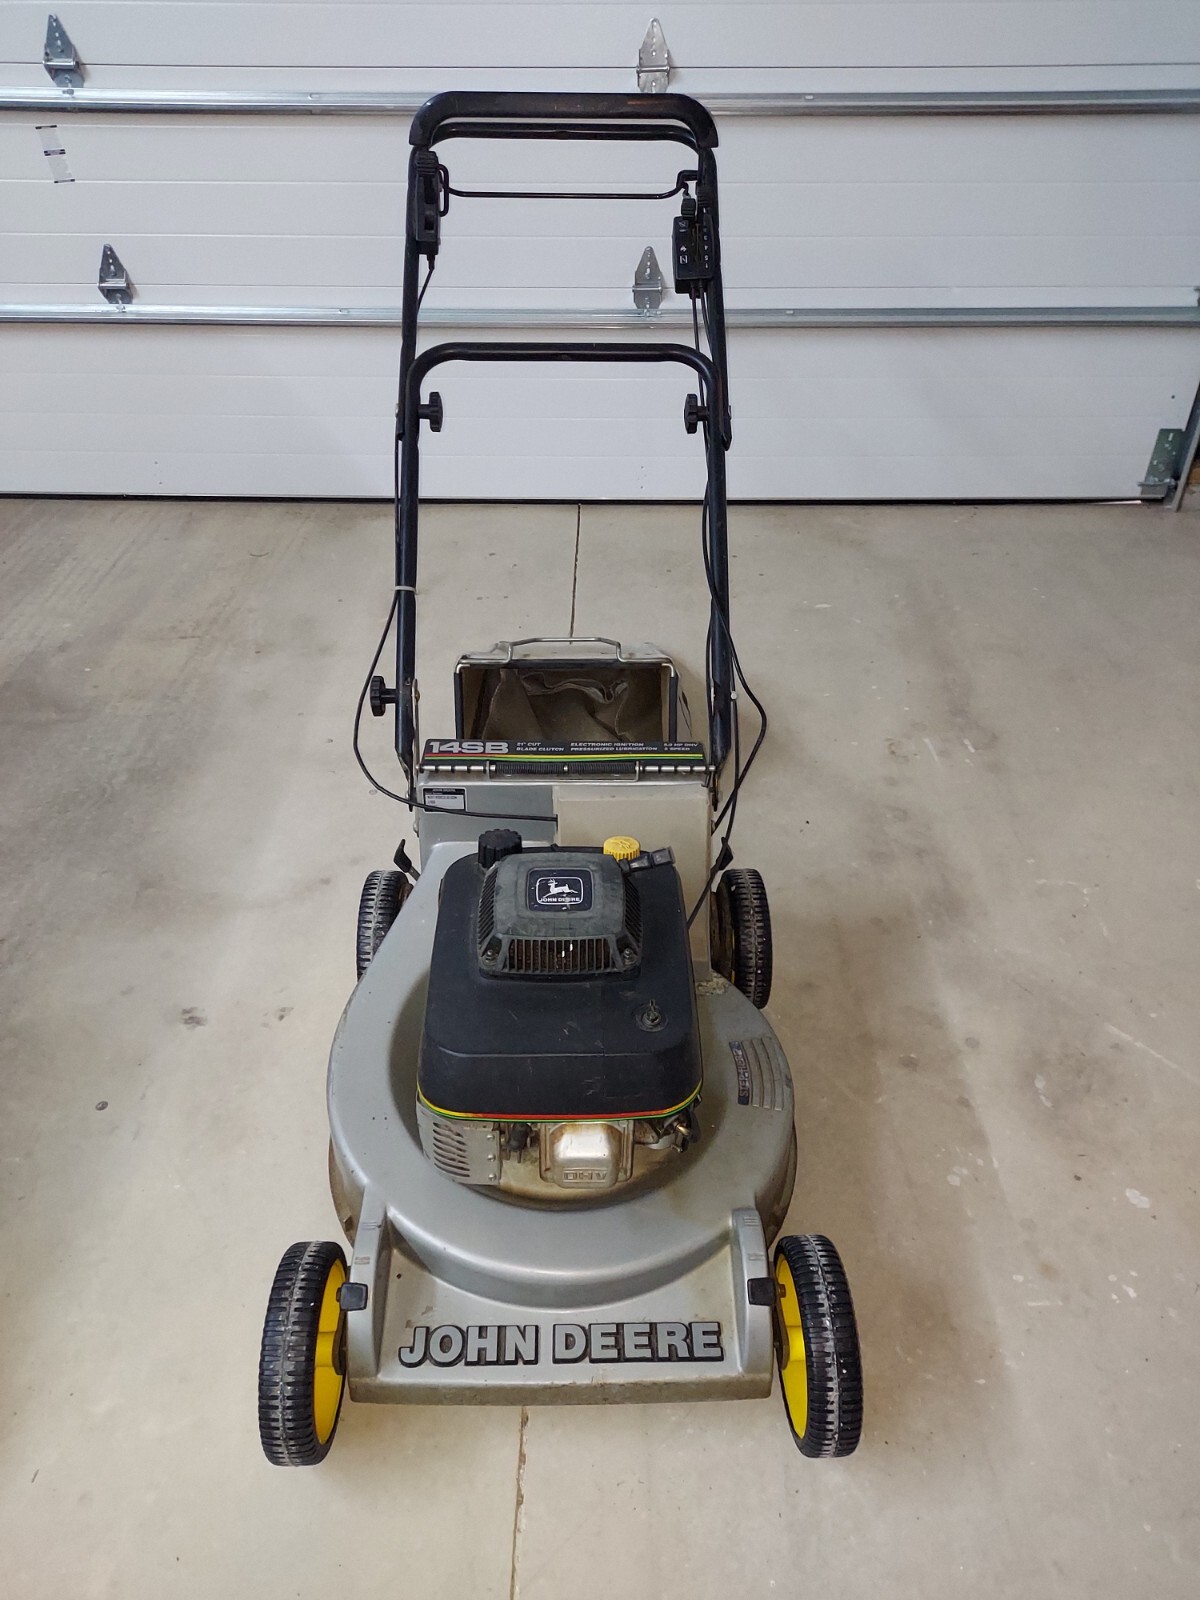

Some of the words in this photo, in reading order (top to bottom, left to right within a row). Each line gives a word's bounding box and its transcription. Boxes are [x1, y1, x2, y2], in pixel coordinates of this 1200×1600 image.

[429, 741, 509, 754] 14SB
[563, 1170, 608, 1181] OHV
[398, 1324, 539, 1368] JOHN
[552, 1321, 724, 1364] DEERE
